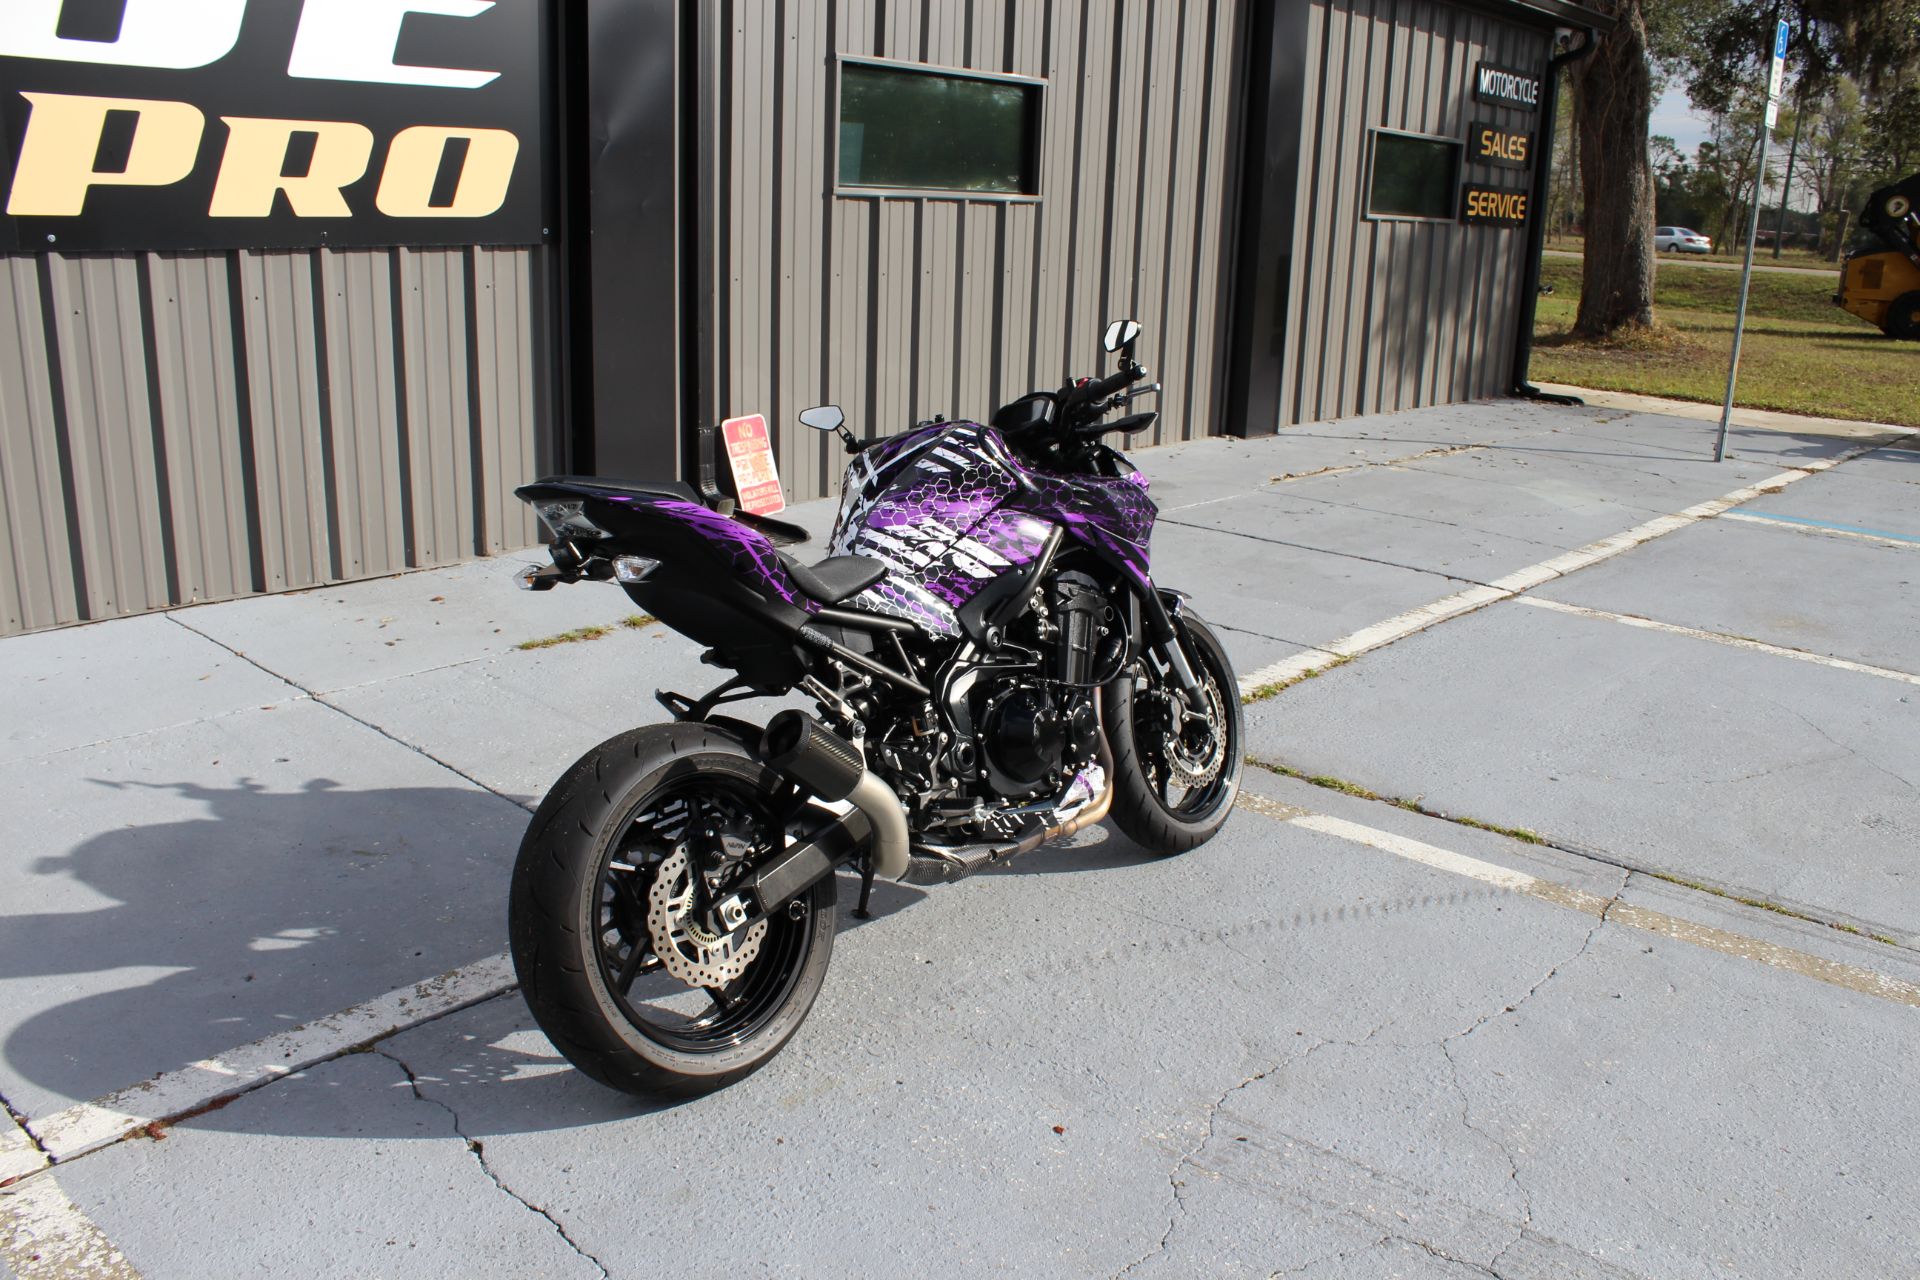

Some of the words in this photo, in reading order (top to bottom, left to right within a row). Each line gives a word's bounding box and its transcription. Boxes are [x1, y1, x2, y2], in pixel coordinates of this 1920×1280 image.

[1479, 68, 1539, 105] MOTORCYCLE
[6, 91, 520, 218] PRO
[1480, 130, 1527, 161] SALES
[1467, 190, 1527, 220] SERVICE
[738, 422, 753, 438] NO
